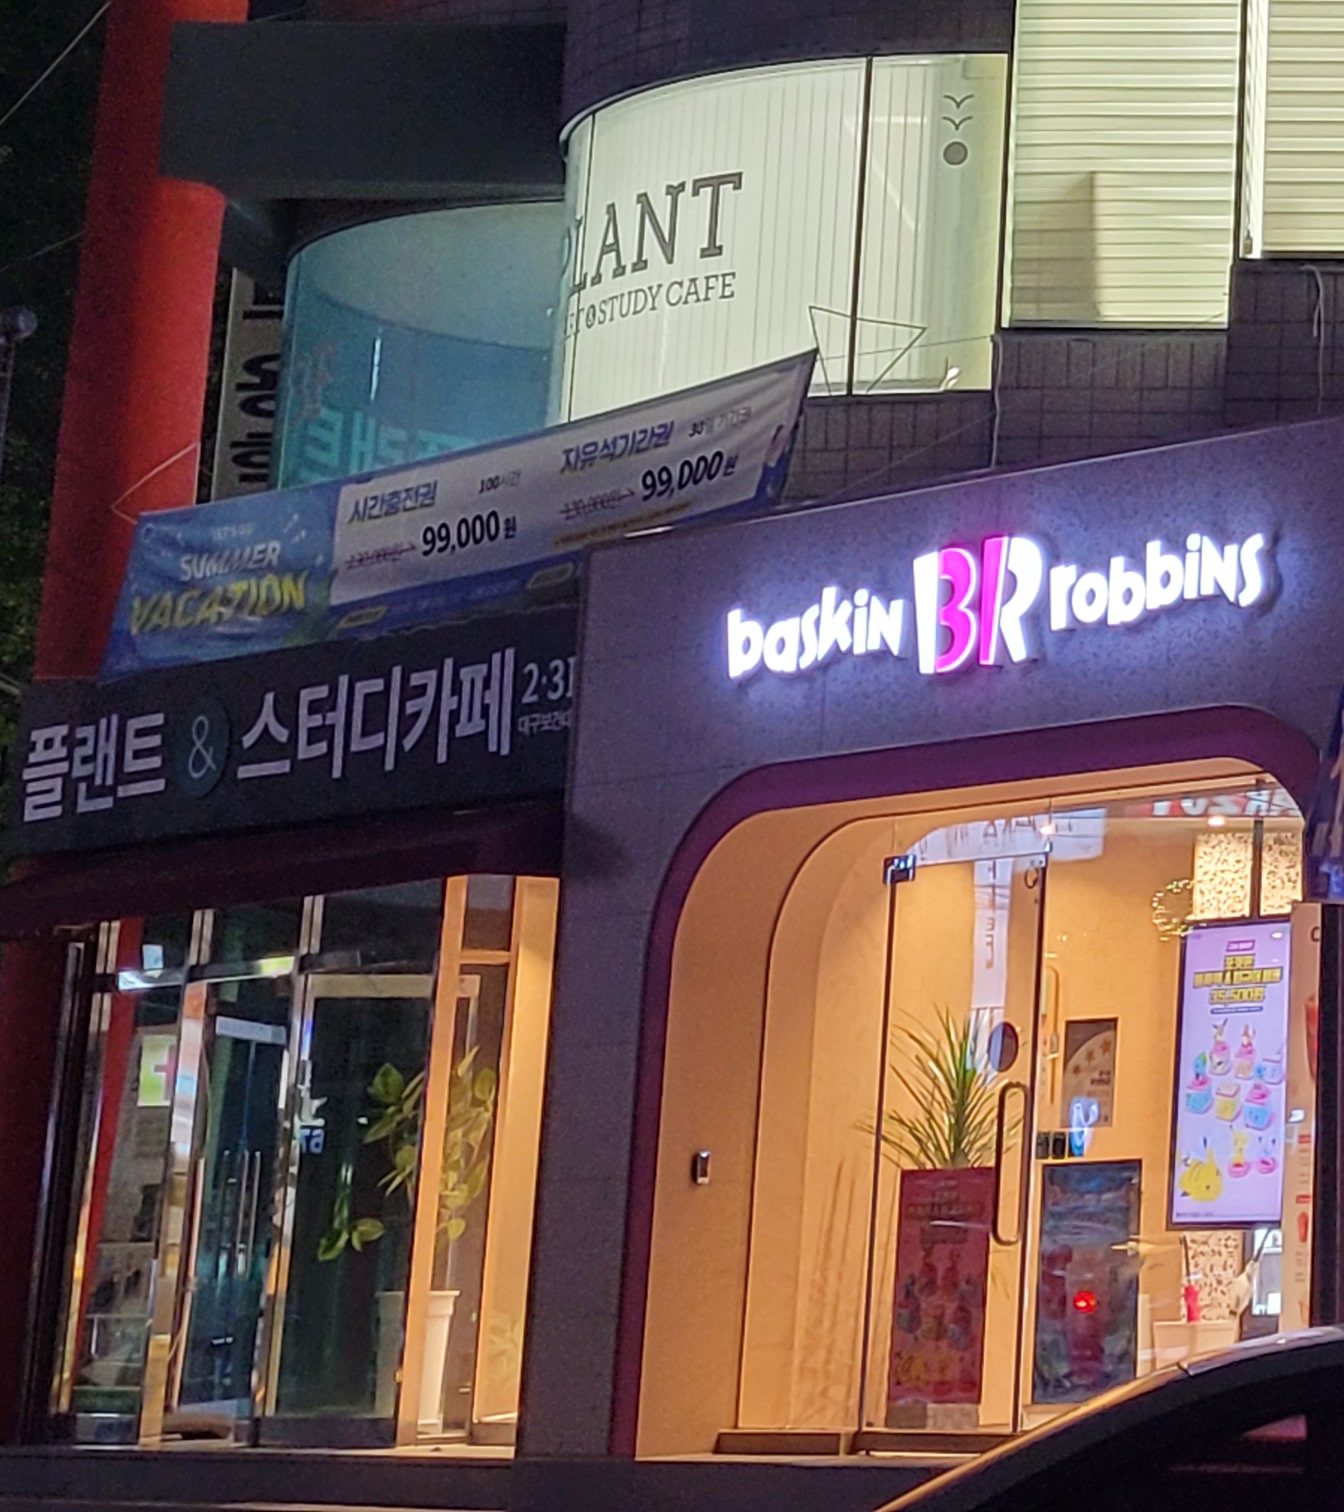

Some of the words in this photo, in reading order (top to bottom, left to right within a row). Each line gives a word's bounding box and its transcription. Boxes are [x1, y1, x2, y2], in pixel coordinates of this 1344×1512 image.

[666, 272, 737, 307] CAFE
[179, 540, 282, 582] SUMMER
[130, 570, 309, 637] VACATION
[727, 586, 905, 679] baskin
[1048, 532, 1266, 633] robbins
[22, 712, 166, 823] 플랜트
[236, 647, 516, 781] 스터디카페
